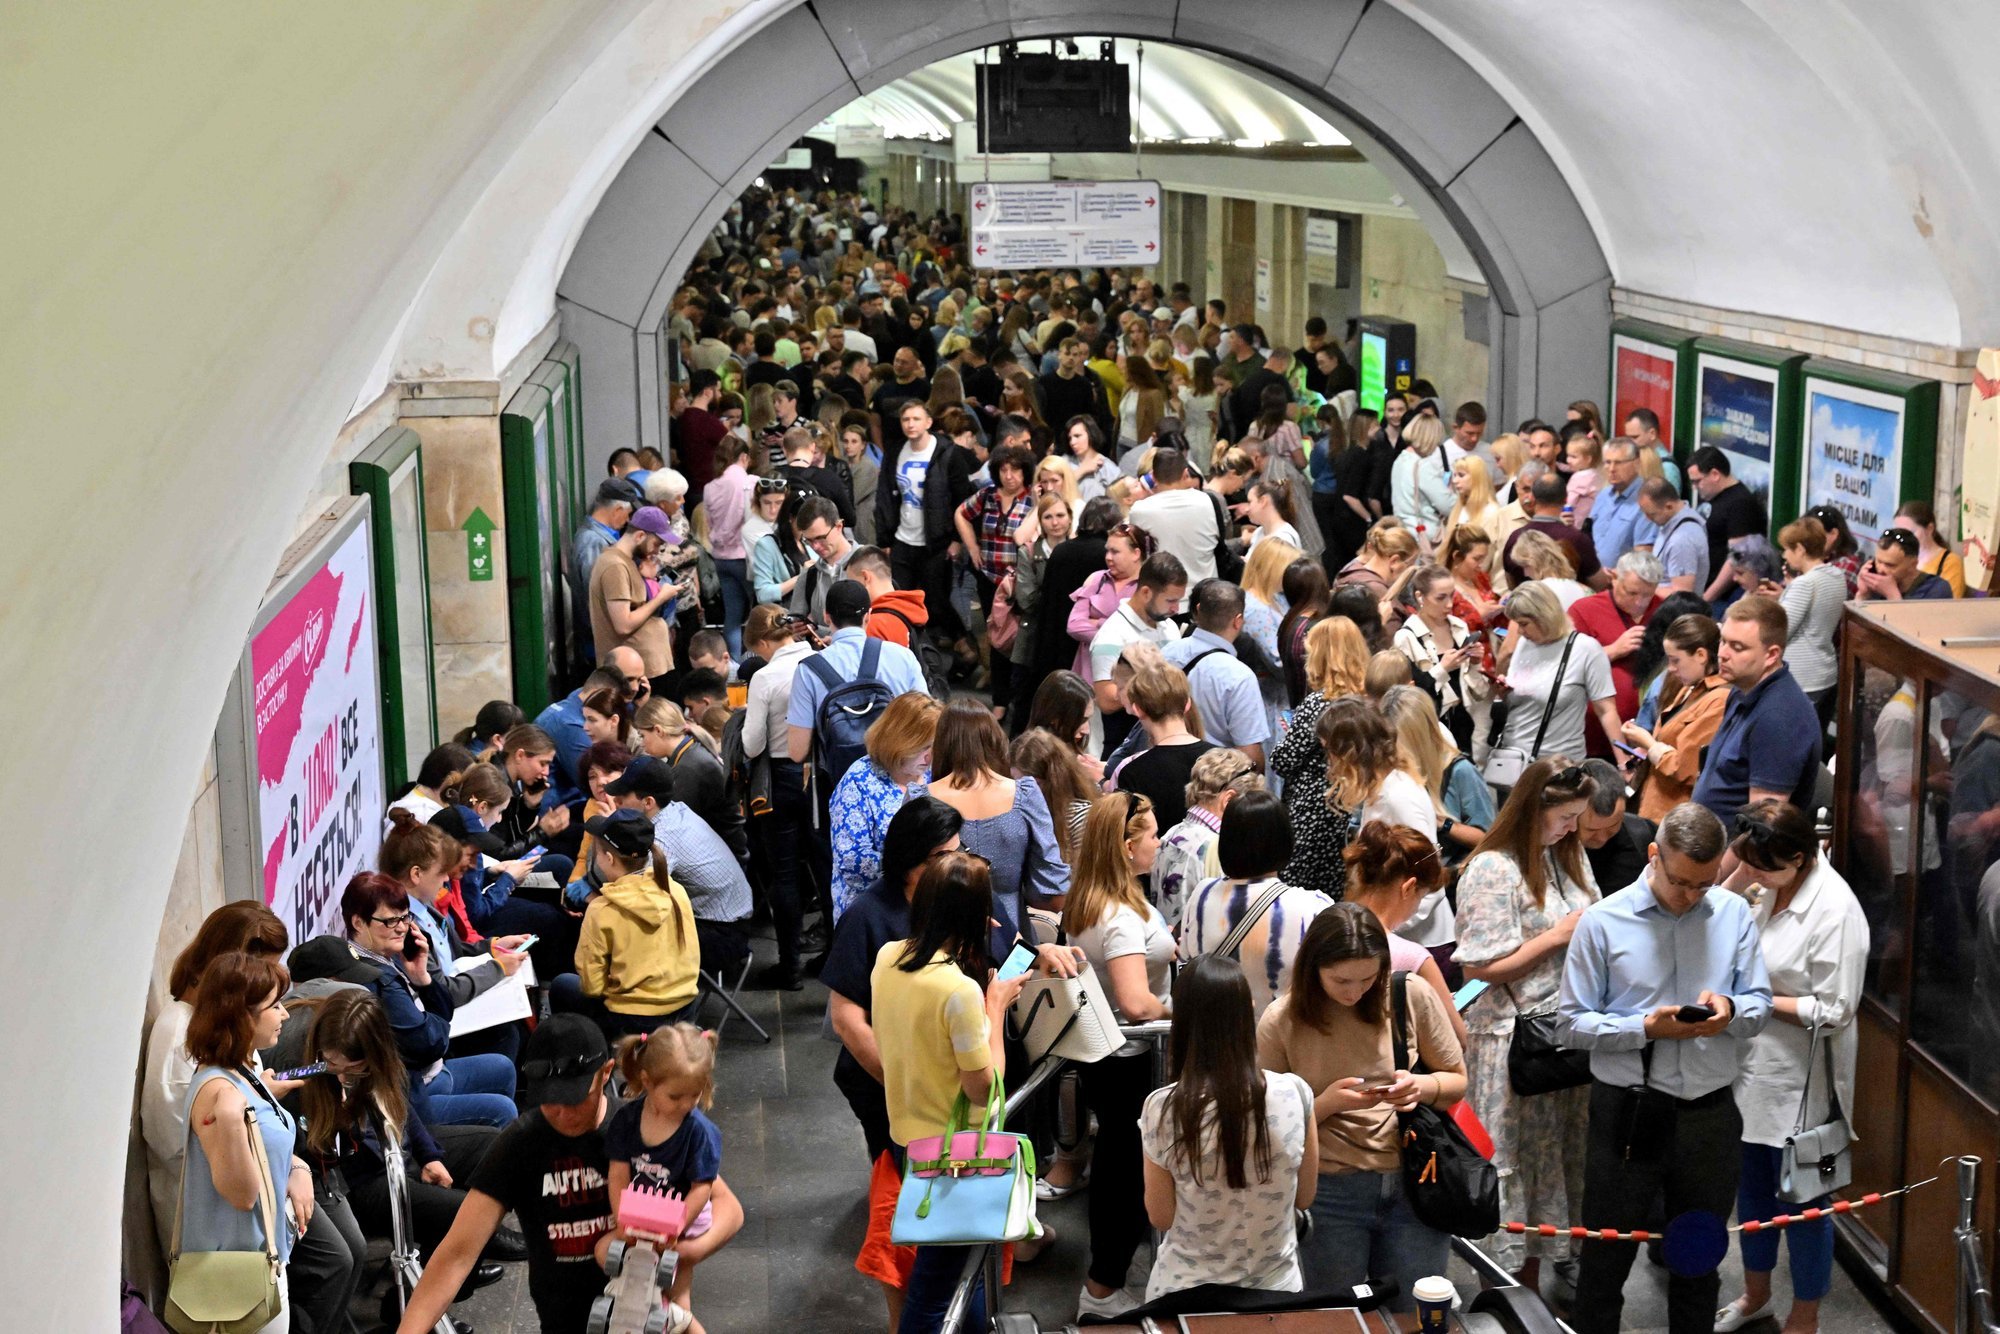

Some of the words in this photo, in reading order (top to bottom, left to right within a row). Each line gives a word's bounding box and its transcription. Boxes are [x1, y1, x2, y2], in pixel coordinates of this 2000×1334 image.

[1824, 442, 1859, 468] МІСЦЕ
[1862, 453, 1885, 474] ДЛЯ
[1835, 473, 1871, 499] ВАШОЇ
[255, 661, 279, 709] ДОСТАВКА
[290, 793, 299, 857] В
[341, 697, 358, 772] ВСЕ
[294, 769, 362, 945] НЕСЕТЬСЯ!
